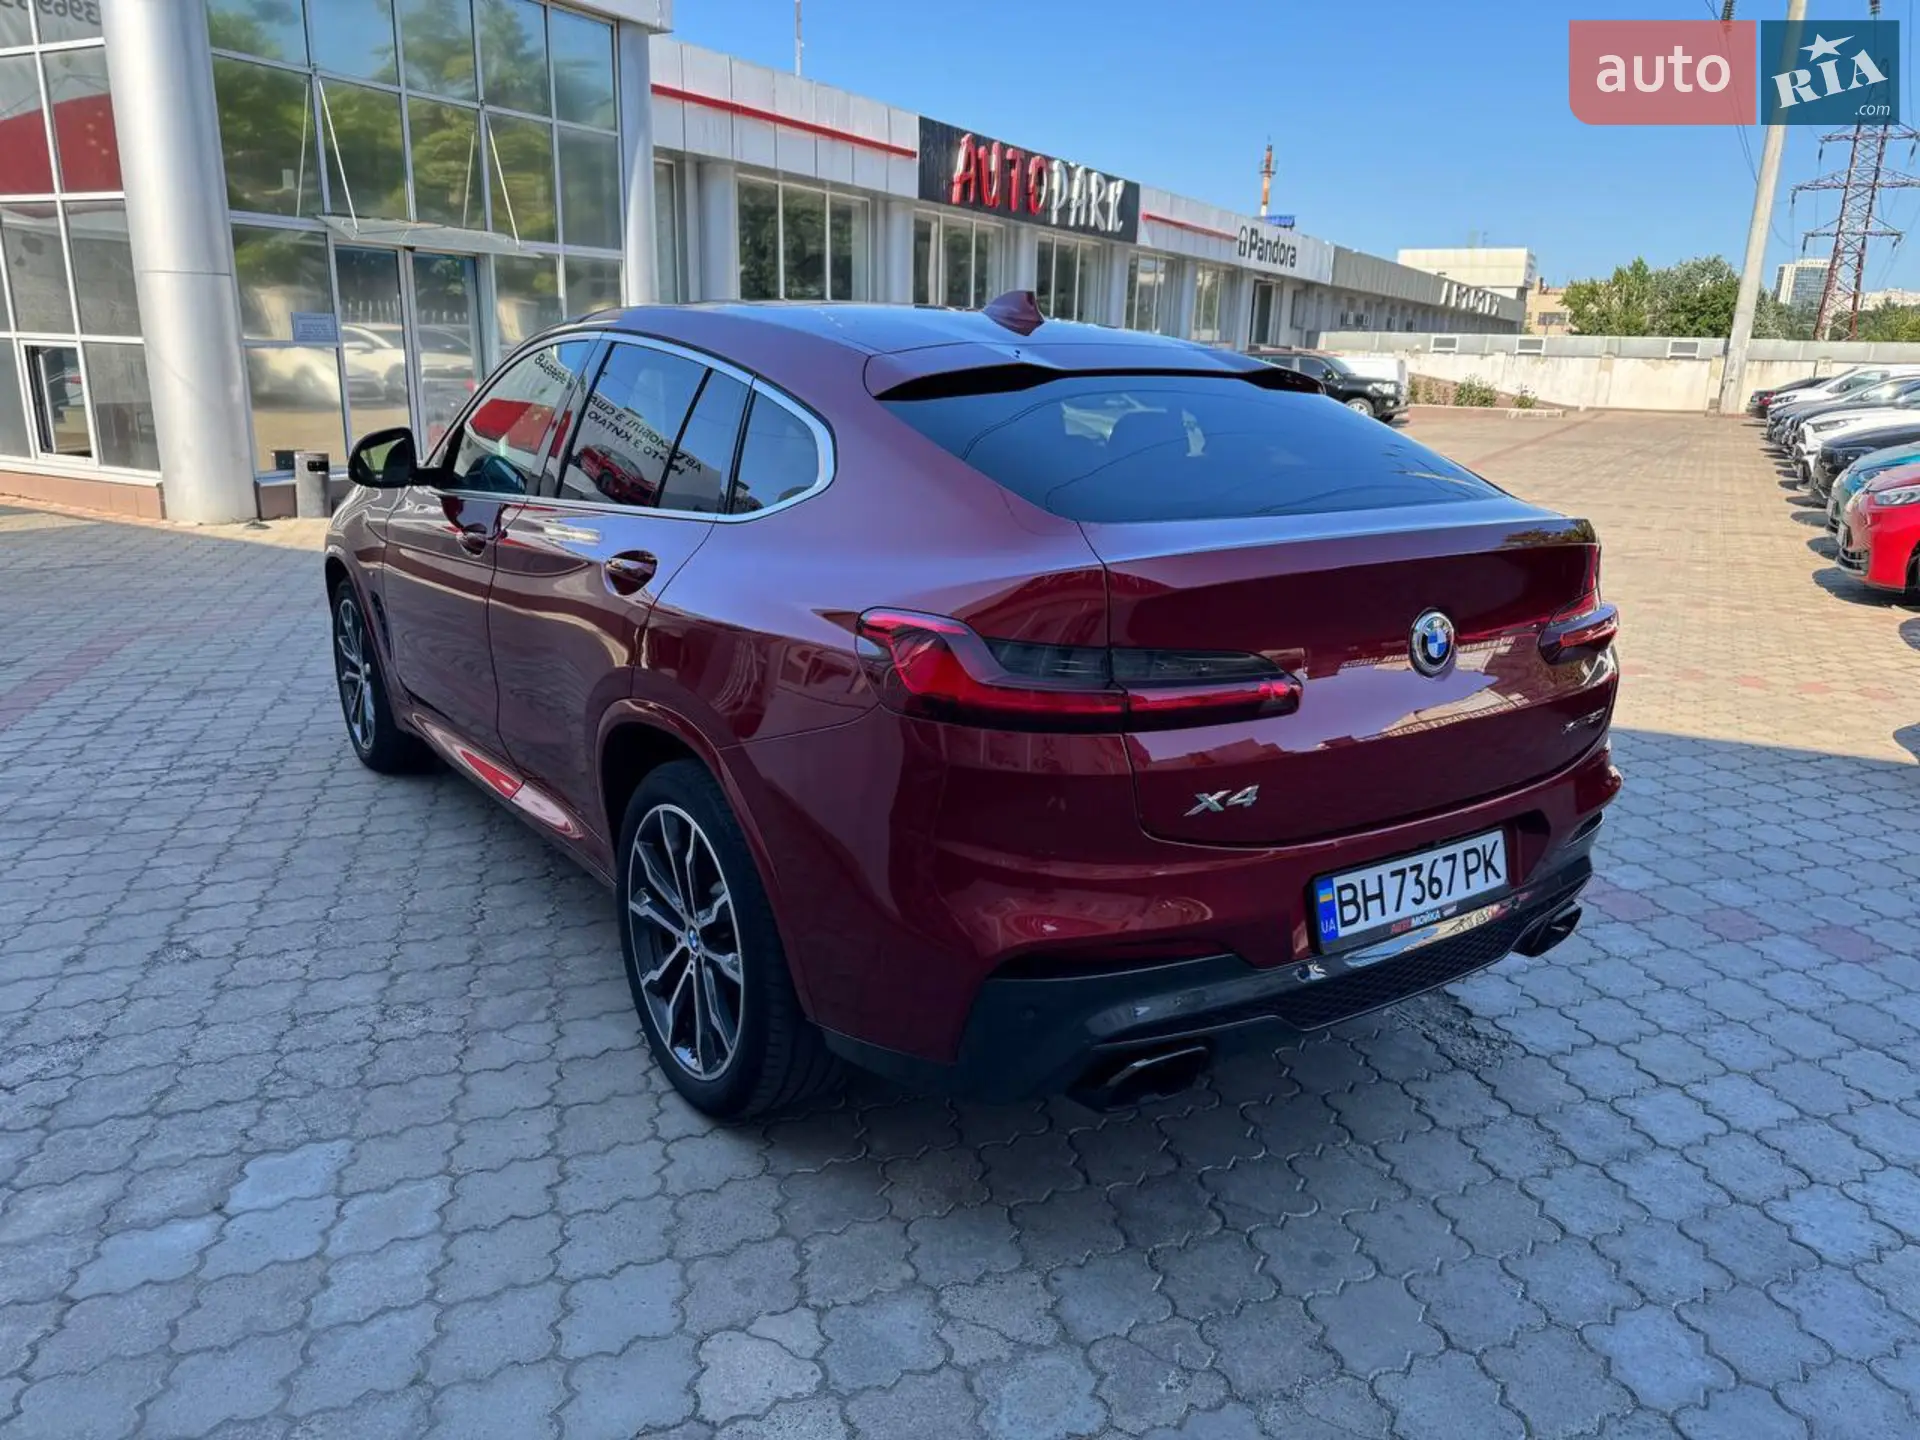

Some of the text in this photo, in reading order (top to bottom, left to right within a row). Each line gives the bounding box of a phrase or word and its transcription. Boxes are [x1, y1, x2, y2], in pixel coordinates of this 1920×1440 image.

[1247, 227, 1297, 269] Pandora
[1182, 784, 1260, 817] X4
[1320, 918, 1337, 935] UA
